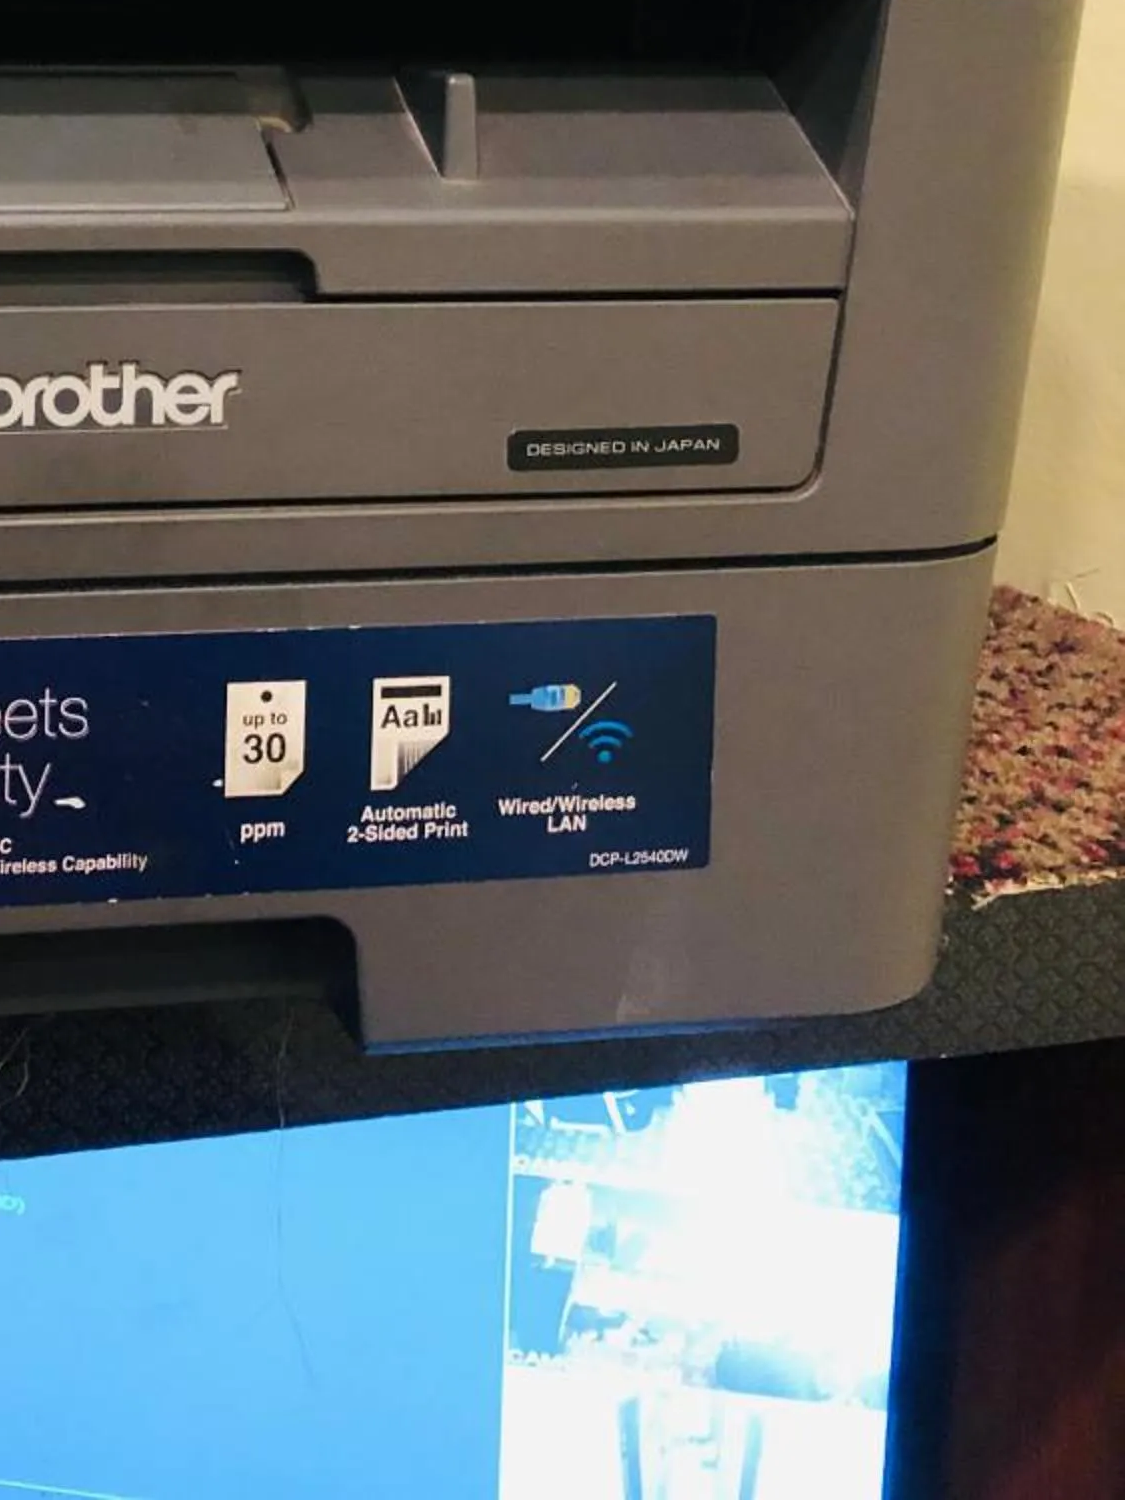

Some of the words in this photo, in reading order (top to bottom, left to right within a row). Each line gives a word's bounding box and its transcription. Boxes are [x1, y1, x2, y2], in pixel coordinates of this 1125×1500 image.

[526, 441, 625, 457] DESIGNED
[630, 441, 650, 453] IN
[654, 439, 720, 453] JAPAN
[242, 714, 265, 729] up
[271, 712, 288, 726] to
[243, 733, 287, 764] 30
[360, 802, 456, 823] Automatic
[498, 794, 636, 816] Wired/Wireless
[240, 821, 286, 843] ppm
[347, 824, 418, 843] 2-Sided
[424, 821, 468, 839] Print
[547, 815, 587, 833] LAN
[62, 853, 148, 876] Capability
[589, 848, 689, 868] DCP-L2540DW
